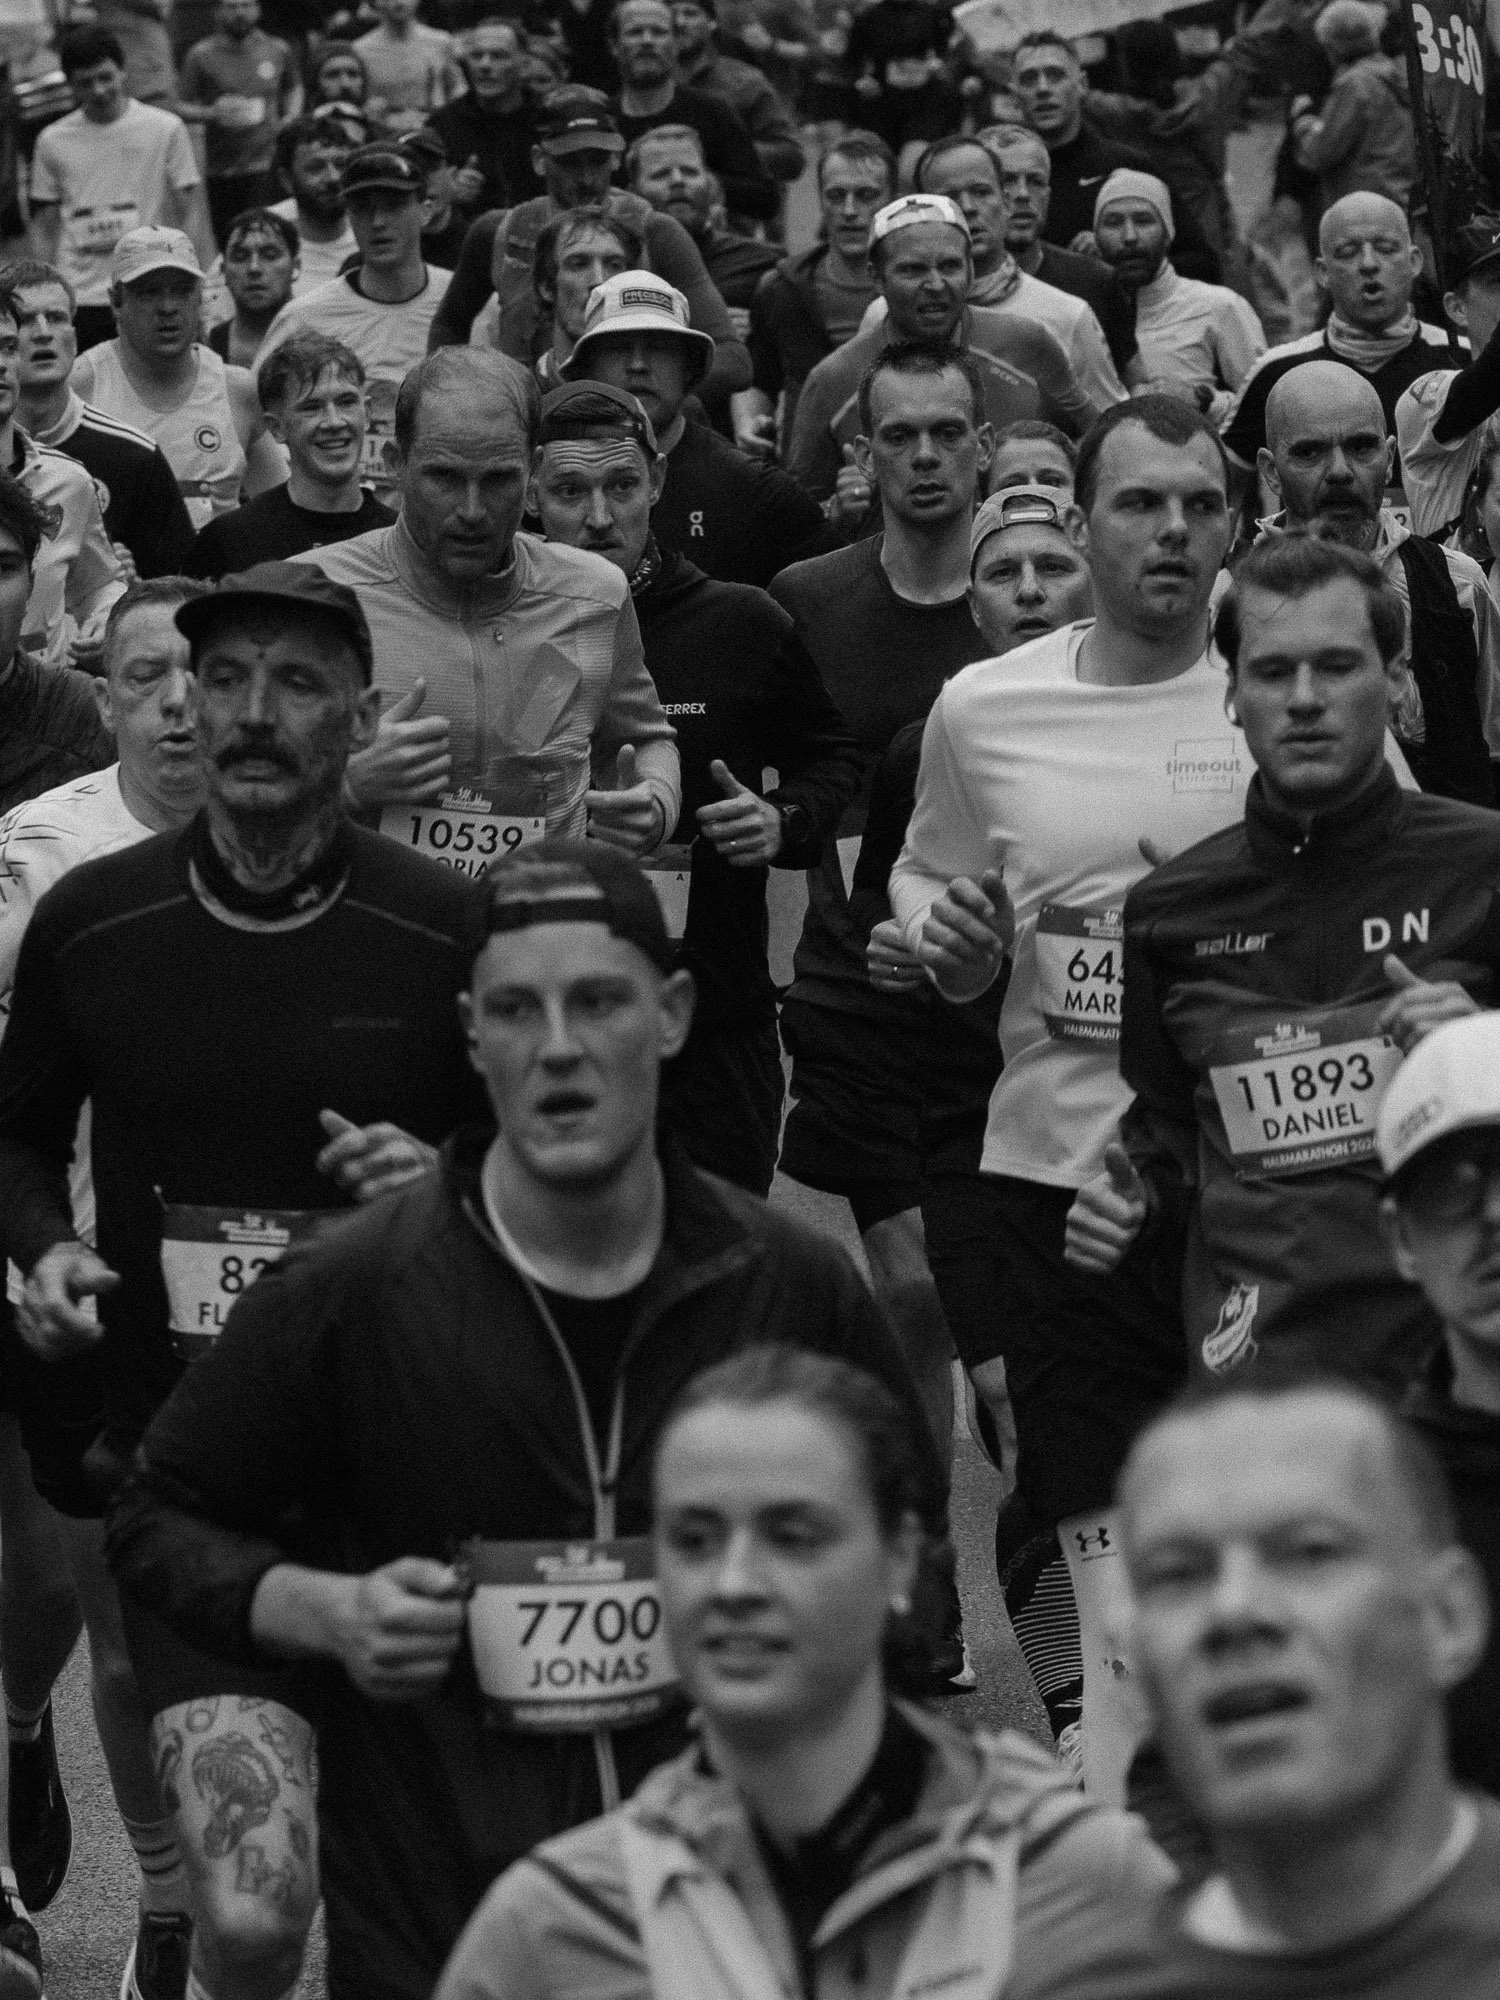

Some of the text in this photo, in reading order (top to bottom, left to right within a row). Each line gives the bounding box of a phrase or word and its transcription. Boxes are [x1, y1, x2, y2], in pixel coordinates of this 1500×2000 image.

[1411, 3, 1484, 96] 3:30
[199, 430, 216, 449] C
[1166, 758, 1241, 776] timeout
[411, 815, 523, 857] 10539
[676, 873, 684, 882] A
[1068, 948, 1123, 985] 64
[1064, 989, 1117, 1015] MAR
[1237, 1053, 1374, 1112] 11893
[1262, 1102, 1364, 1141] DANIEL
[517, 1595, 660, 1646] 7700
[529, 1653, 650, 1688] JONAS
